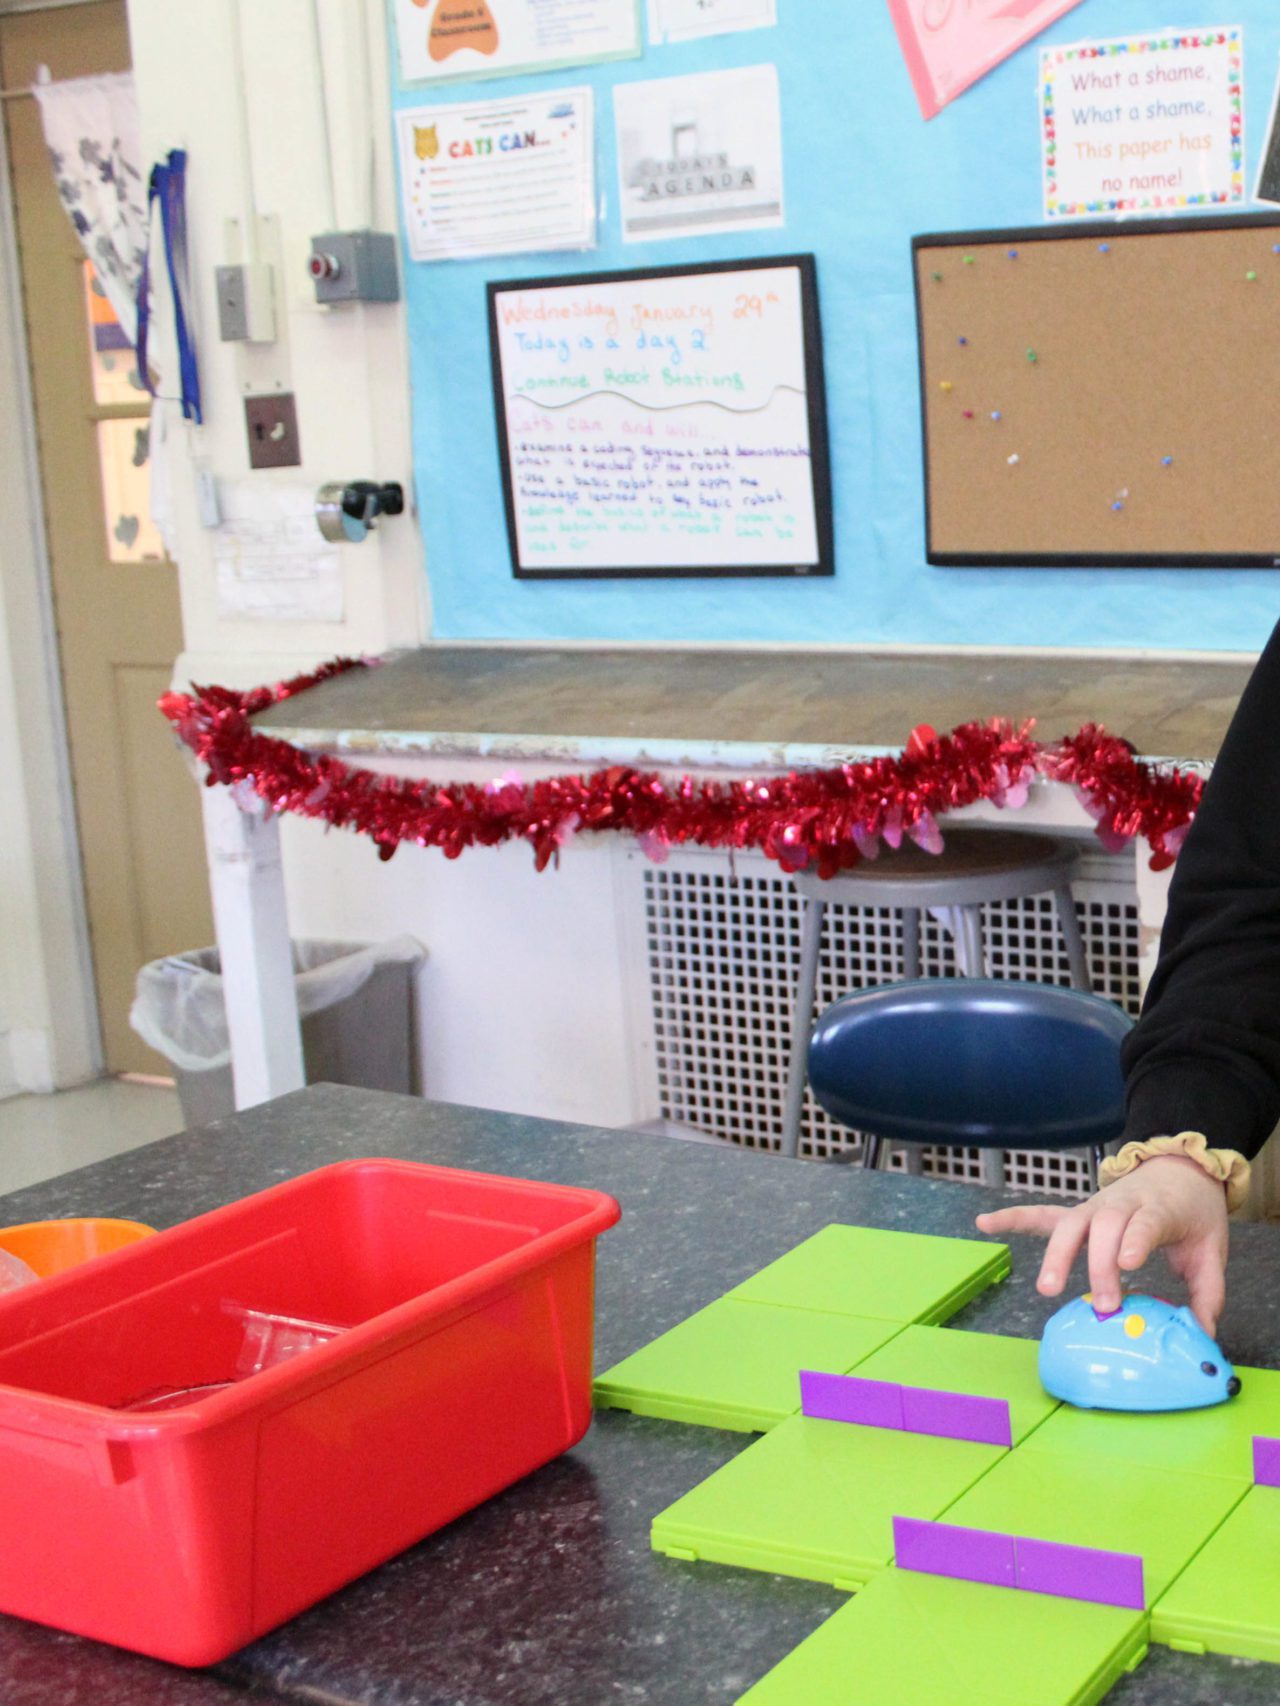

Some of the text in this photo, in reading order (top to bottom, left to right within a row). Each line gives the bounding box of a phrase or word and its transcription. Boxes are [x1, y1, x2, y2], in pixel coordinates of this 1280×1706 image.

[1071, 63, 1212, 92] What a shame,
[1072, 98, 1212, 126] What a shame,
[448, 137, 492, 159] CATS
[1073, 133, 1212, 163] This paper has
[648, 171, 754, 196] AGENDA
[1102, 170, 1184, 193] no name!
[501, 297, 617, 336] Wednesday
[630, 304, 714, 333] January
[514, 328, 707, 365] Today is a day 2
[620, 416, 654, 436] and
